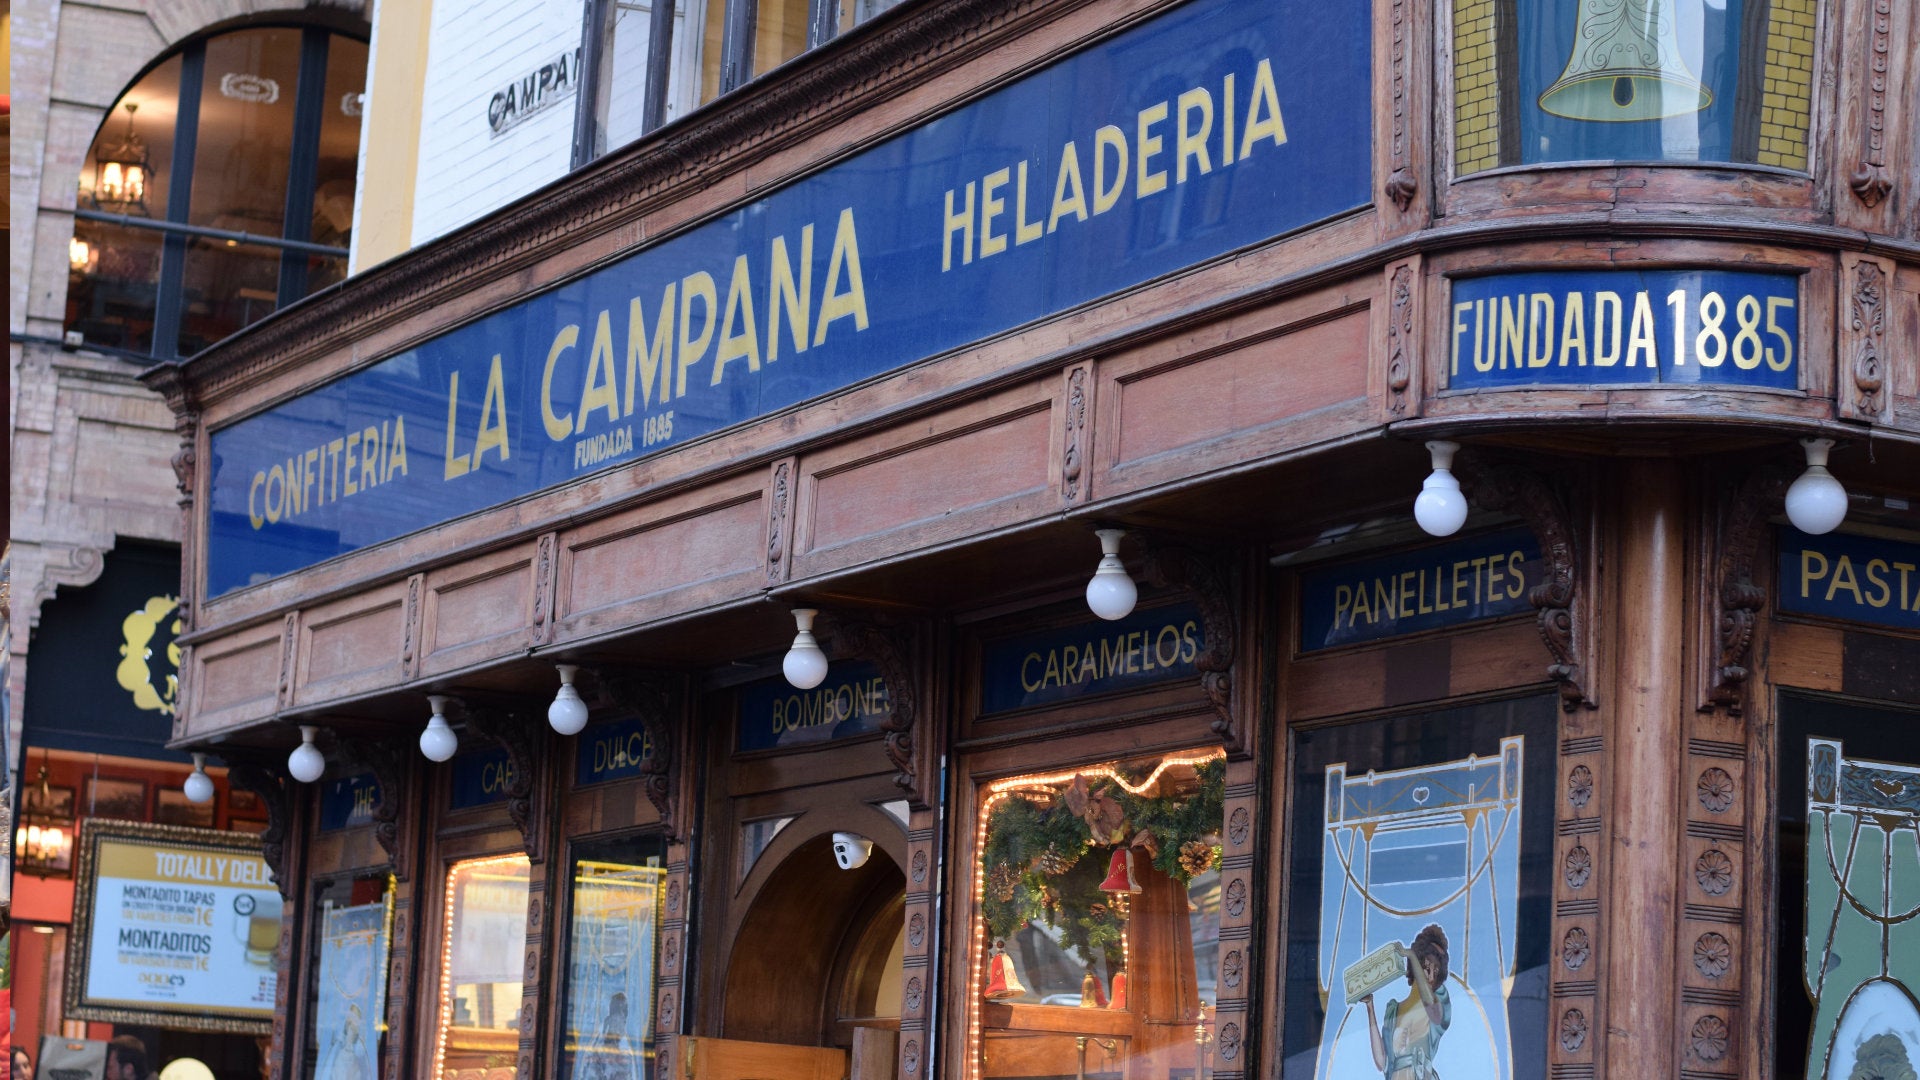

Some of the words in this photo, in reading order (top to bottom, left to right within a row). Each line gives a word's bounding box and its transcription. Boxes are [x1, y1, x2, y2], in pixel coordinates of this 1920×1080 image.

[249, 414, 408, 531] CONFITERIA
[444, 353, 510, 482] LA
[540, 206, 870, 442] CAMPANA
[941, 57, 1289, 273] HELADERIA
[1451, 289, 1658, 377] FUNDADA
[1666, 288, 1795, 373] 1885
[573, 424, 634, 471] FUNDADA
[642, 410, 674, 448] 1885
[1333, 551, 1526, 631] PANELLETES
[1020, 619, 1198, 694] CARAMELOS
[122, 884, 181, 904] MONTADITO
[183, 889, 216, 907] TAPAS
[154, 851, 227, 881] TOTALLY
[118, 927, 212, 954] MONTADITOS
